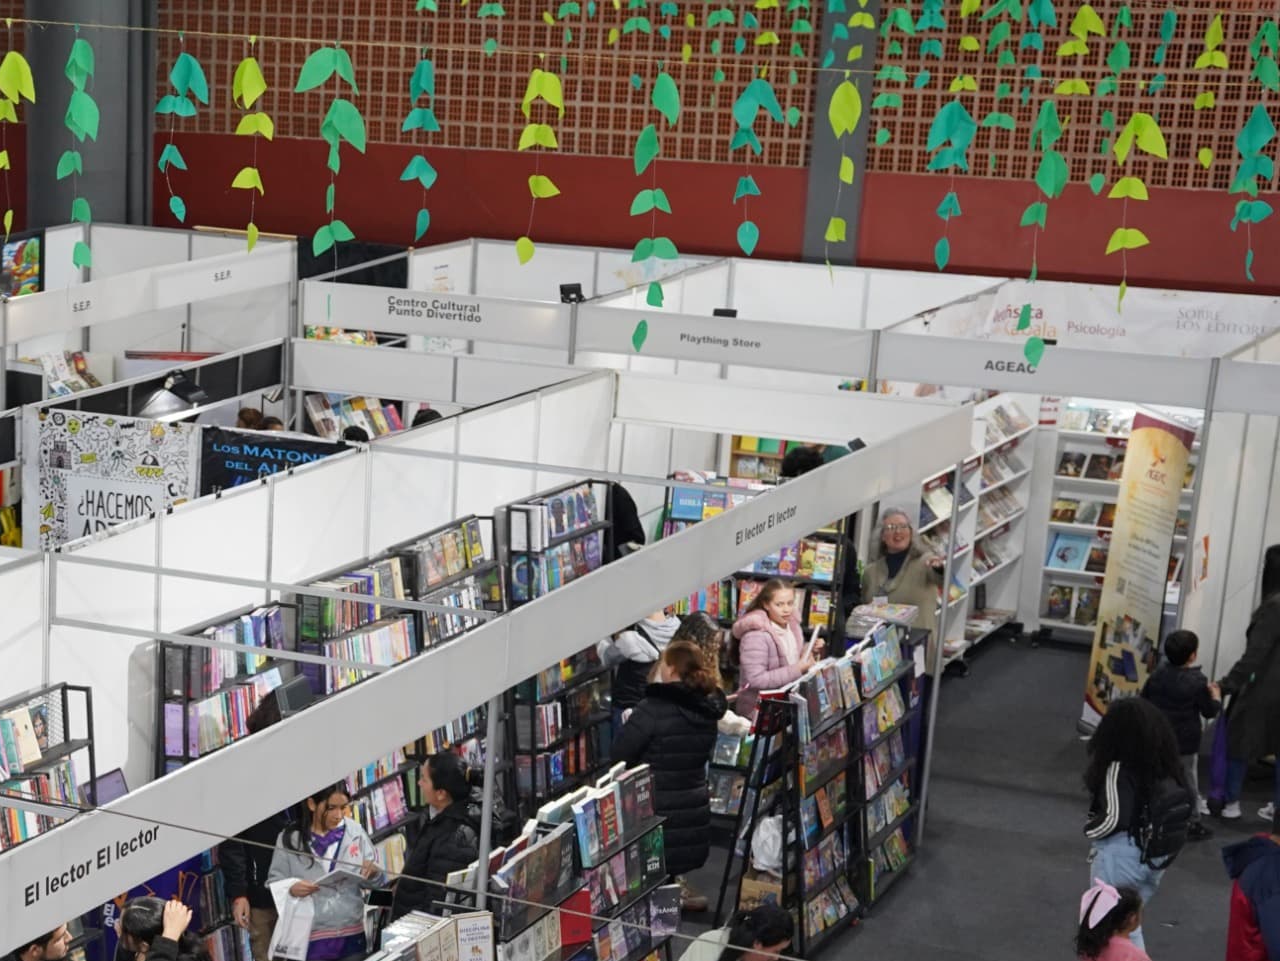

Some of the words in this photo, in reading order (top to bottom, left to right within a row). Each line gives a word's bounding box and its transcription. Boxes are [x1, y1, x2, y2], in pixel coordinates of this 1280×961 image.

[387, 295, 427, 311] Centro
[431, 300, 481, 313] Cultural
[387, 306, 424, 319] Punto
[426, 307, 482, 323] Divertido
[679, 332, 729, 348] Plaything
[732, 337, 762, 349] Store
[213, 443, 241, 455] LOS
[242, 444, 329, 463] MATON
[225, 460, 251, 471] DEL
[735, 530, 744, 546] El
[744, 521, 766, 540] lector
[767, 514, 775, 529] El
[776, 505, 797, 526] lector
[24, 882, 40, 908] El
[45, 859, 92, 897] lector
[96, 846, 111, 871] El
[115, 824, 160, 861] lector
